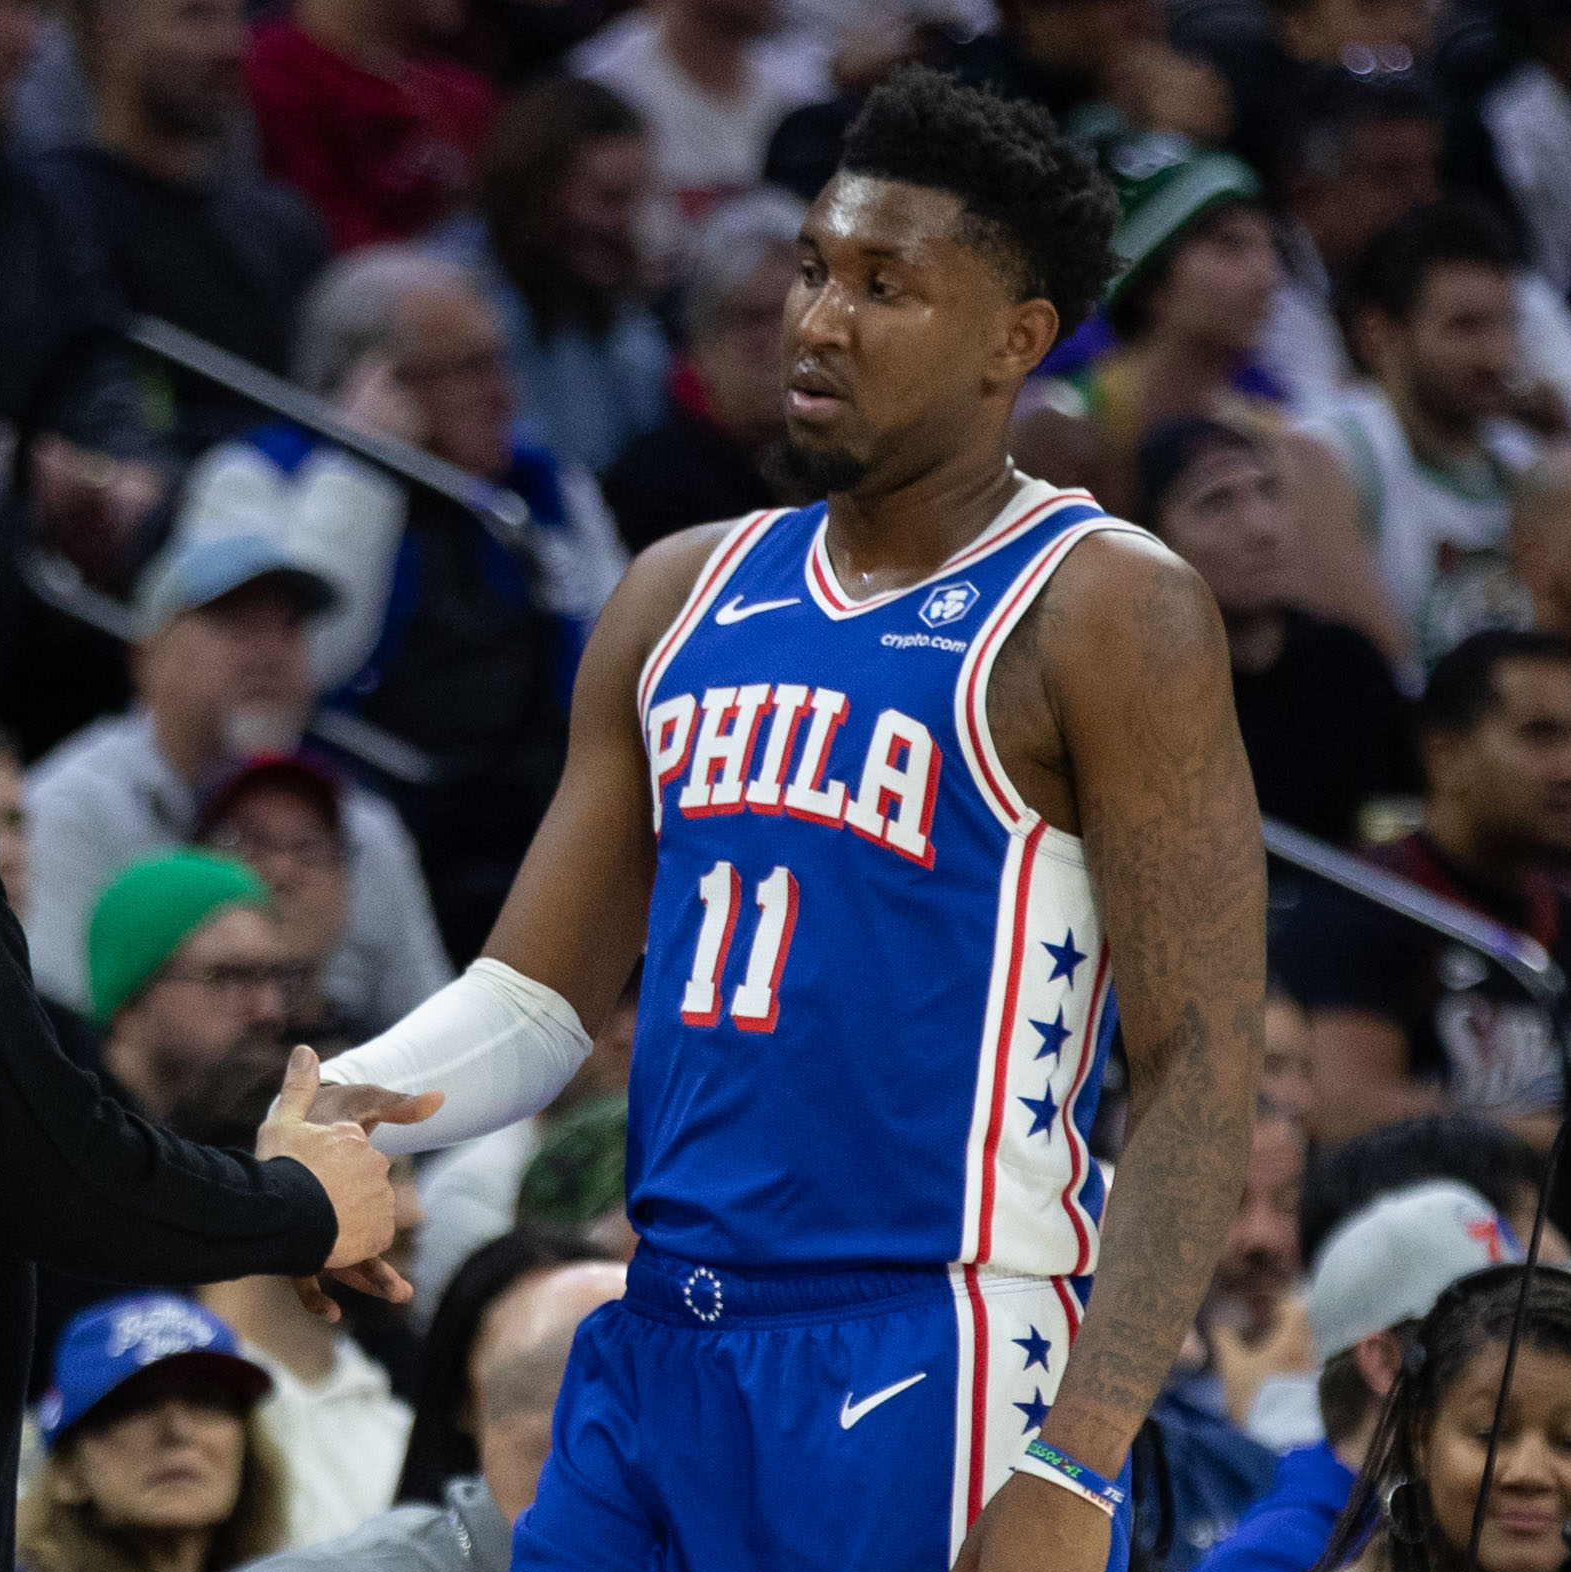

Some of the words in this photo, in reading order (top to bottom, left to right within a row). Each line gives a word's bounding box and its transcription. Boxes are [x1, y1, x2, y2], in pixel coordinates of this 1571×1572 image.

[881, 633, 968, 653] crypto.com
[648, 683, 942, 870] PHILA
[680, 860, 799, 1033] 11
